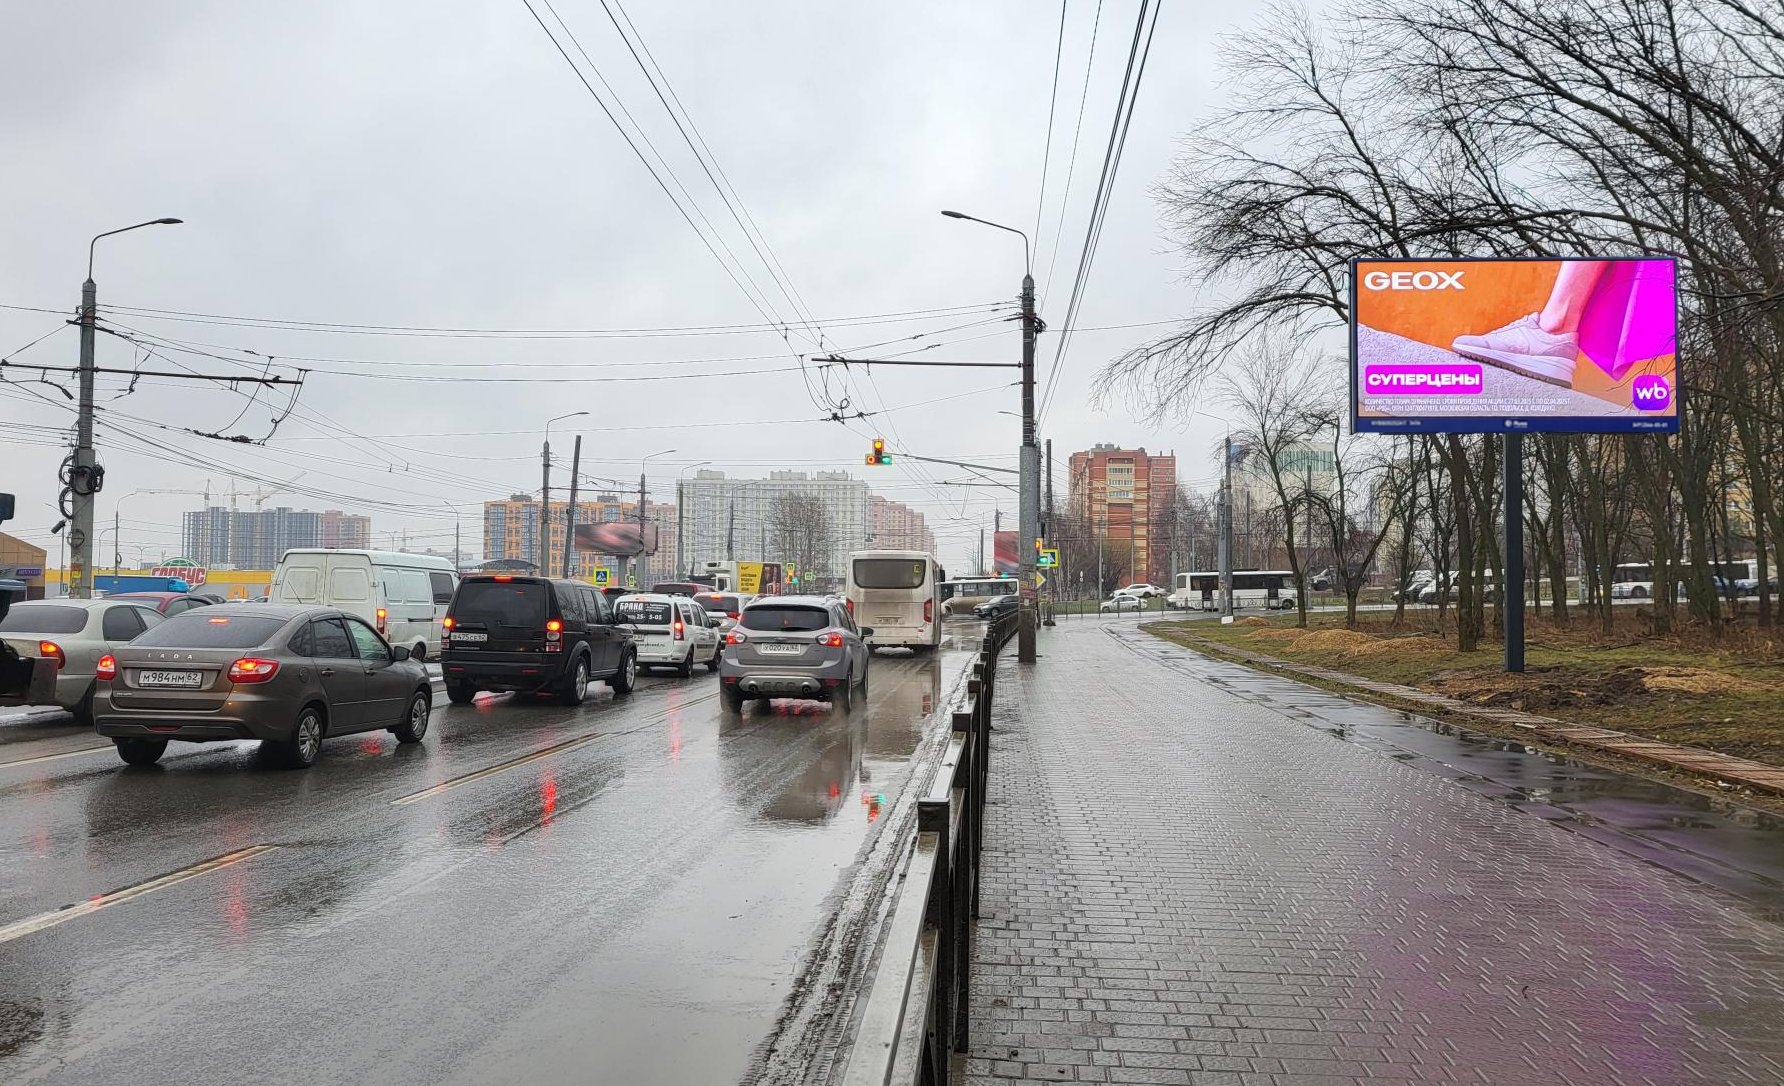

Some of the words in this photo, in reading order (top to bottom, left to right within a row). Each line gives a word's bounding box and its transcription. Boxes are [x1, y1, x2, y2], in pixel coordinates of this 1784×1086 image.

[1364, 271, 1465, 291] GEOX
[1368, 373, 1480, 388] СУПЕРЦЕНЫ
[1635, 382, 1668, 400] wb
[147, 652, 193, 660] LADA
[142, 672, 185, 683] М984НМ
